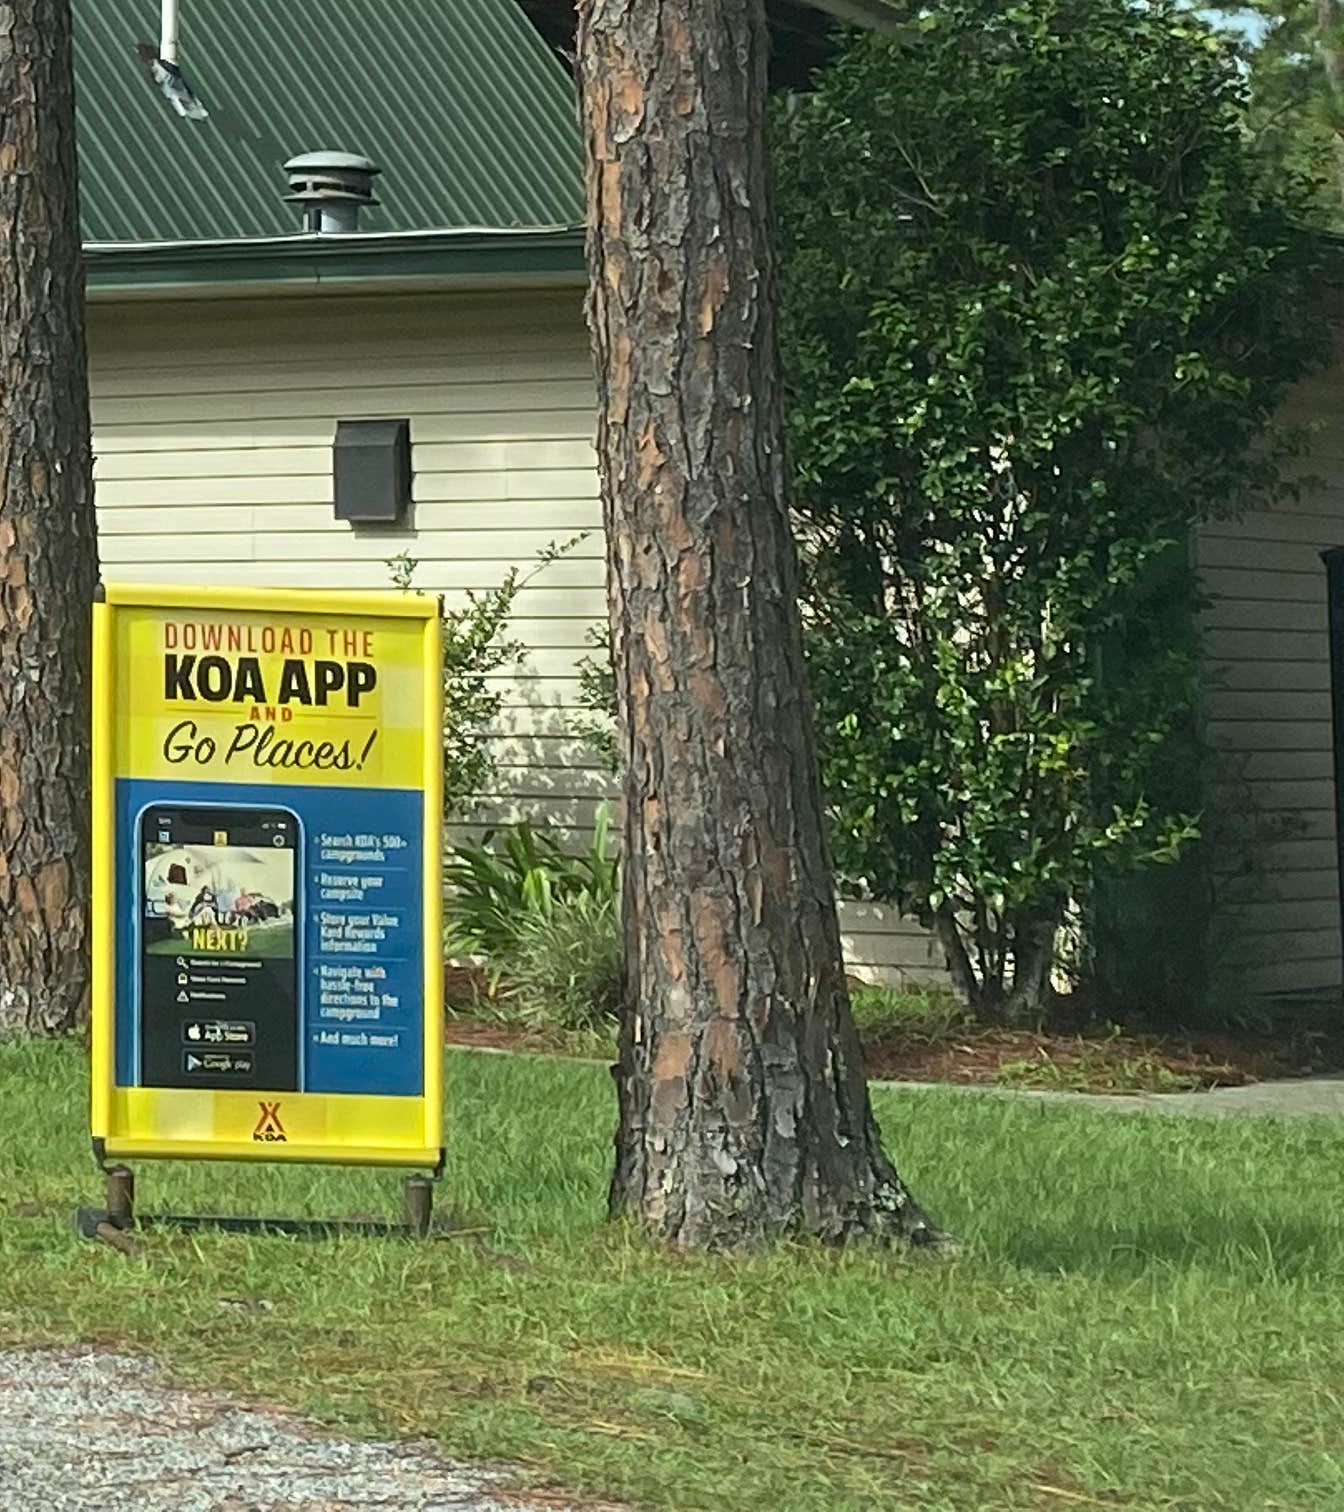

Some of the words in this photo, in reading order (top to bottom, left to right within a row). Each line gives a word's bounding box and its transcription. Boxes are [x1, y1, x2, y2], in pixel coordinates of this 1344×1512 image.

[165, 622, 312, 655] DOWNLOAD
[325, 629, 374, 658] THE
[164, 653, 267, 704] KOA
[277, 659, 377, 707] APP
[249, 706, 292, 722] AND
[163, 720, 216, 764] Go
[224, 723, 378, 771] Places!
[320, 833, 353, 848] Search
[193, 928, 248, 952] NEXT?
[252, 1133, 287, 1142] KOA
